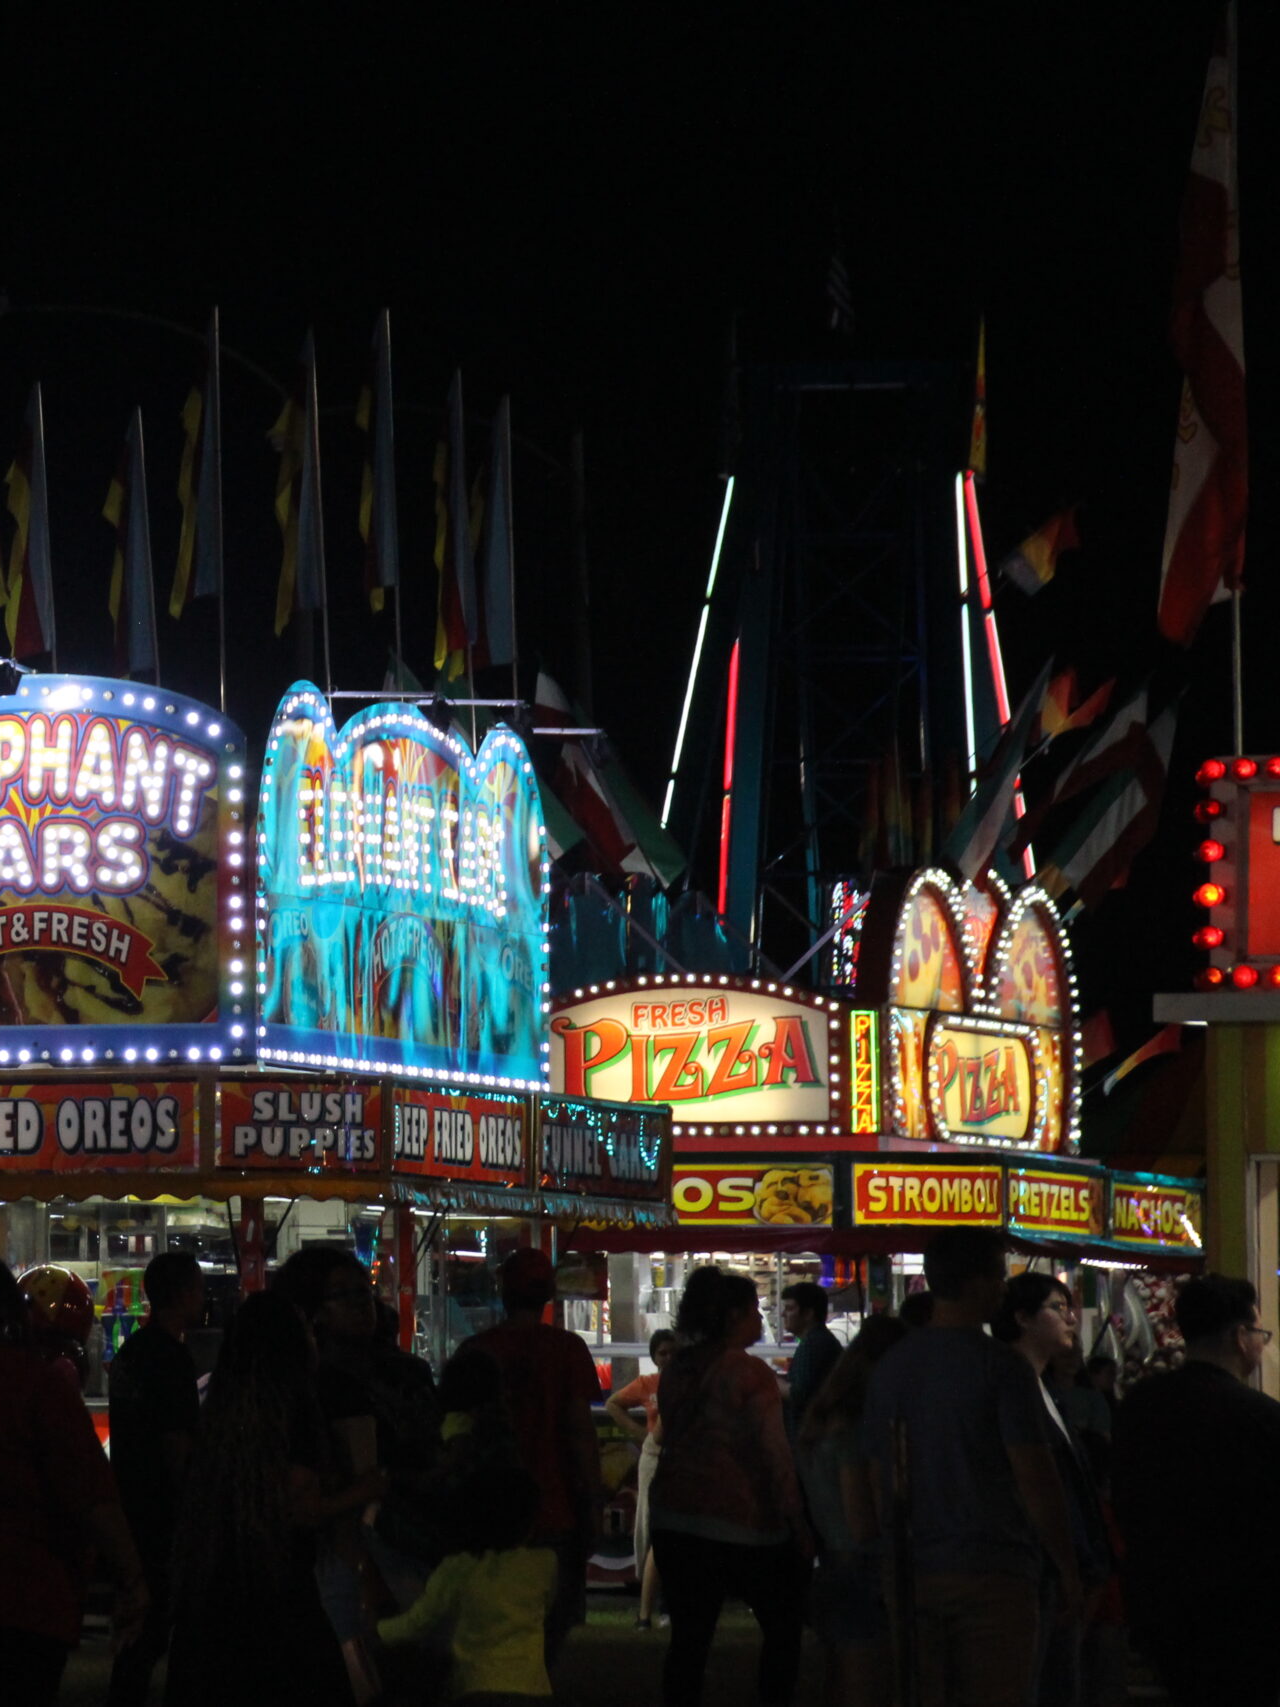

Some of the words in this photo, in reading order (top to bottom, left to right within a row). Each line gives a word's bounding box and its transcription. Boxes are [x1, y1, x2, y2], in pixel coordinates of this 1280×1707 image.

[632, 997, 729, 1029] FRESH
[551, 1016, 827, 1104] PIZZA
[855, 1015, 873, 1133] PIZZA
[929, 1039, 1022, 1124] PIZZA
[57, 1098, 179, 1154] OREOS
[253, 1091, 363, 1122] SLUSH
[233, 1126, 376, 1159] PUPPIES
[393, 1104, 428, 1158] DEEP
[433, 1109, 474, 1161] FRIED
[478, 1115, 521, 1170] OREOS
[542, 1123, 603, 1176] FUNNEL
[868, 1176, 999, 1214] STROMBOLI
[1009, 1179, 1089, 1221] PRETZELS
[1116, 1196, 1185, 1234] NACHOS
